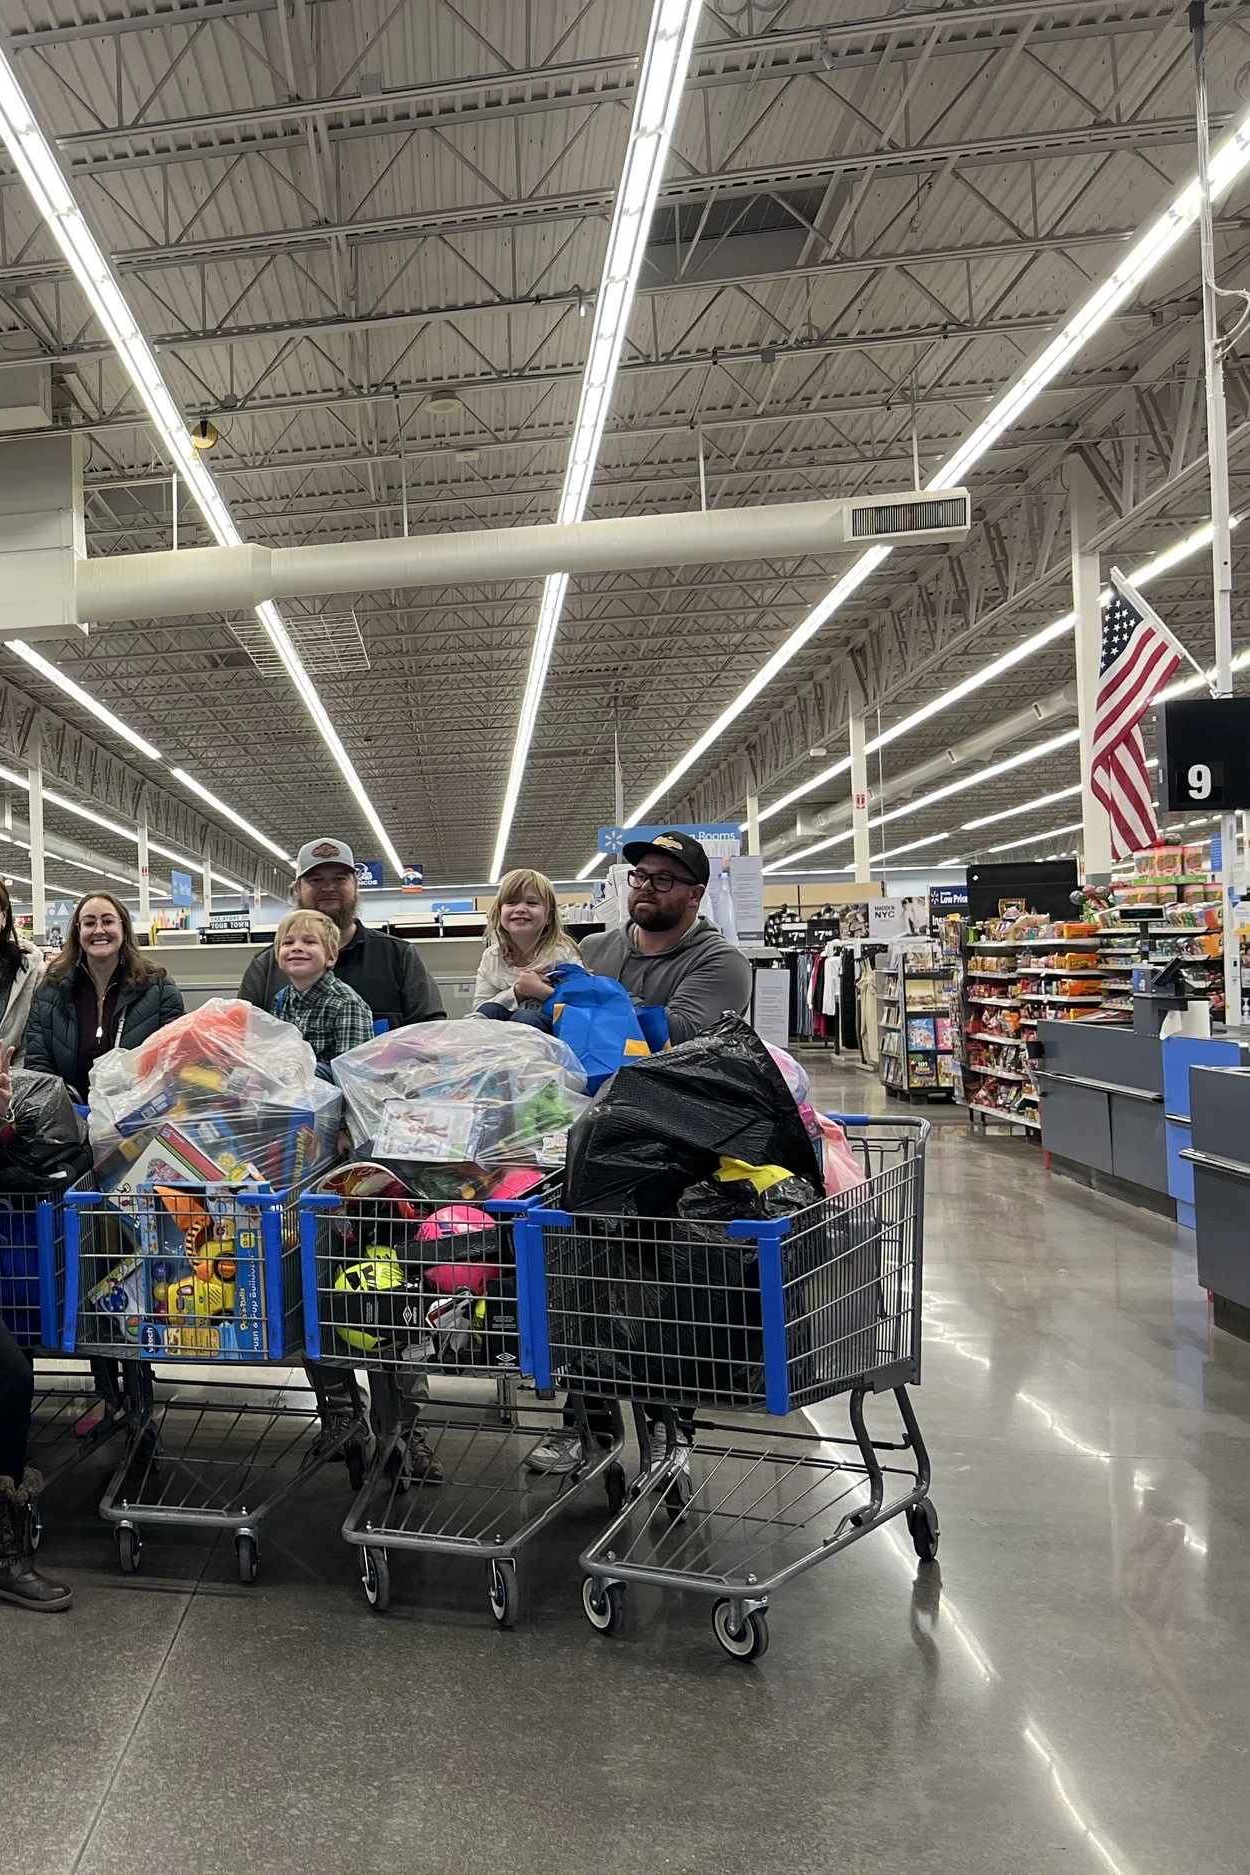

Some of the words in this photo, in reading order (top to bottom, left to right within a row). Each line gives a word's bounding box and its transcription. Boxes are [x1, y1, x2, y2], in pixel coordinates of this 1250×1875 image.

[1188, 764, 1211, 799] 9
[699, 832, 736, 840] Rooms
[940, 895, 953, 904] Low
[874, 911, 895, 919] NYC
[230, 921, 249, 929] TOWN
